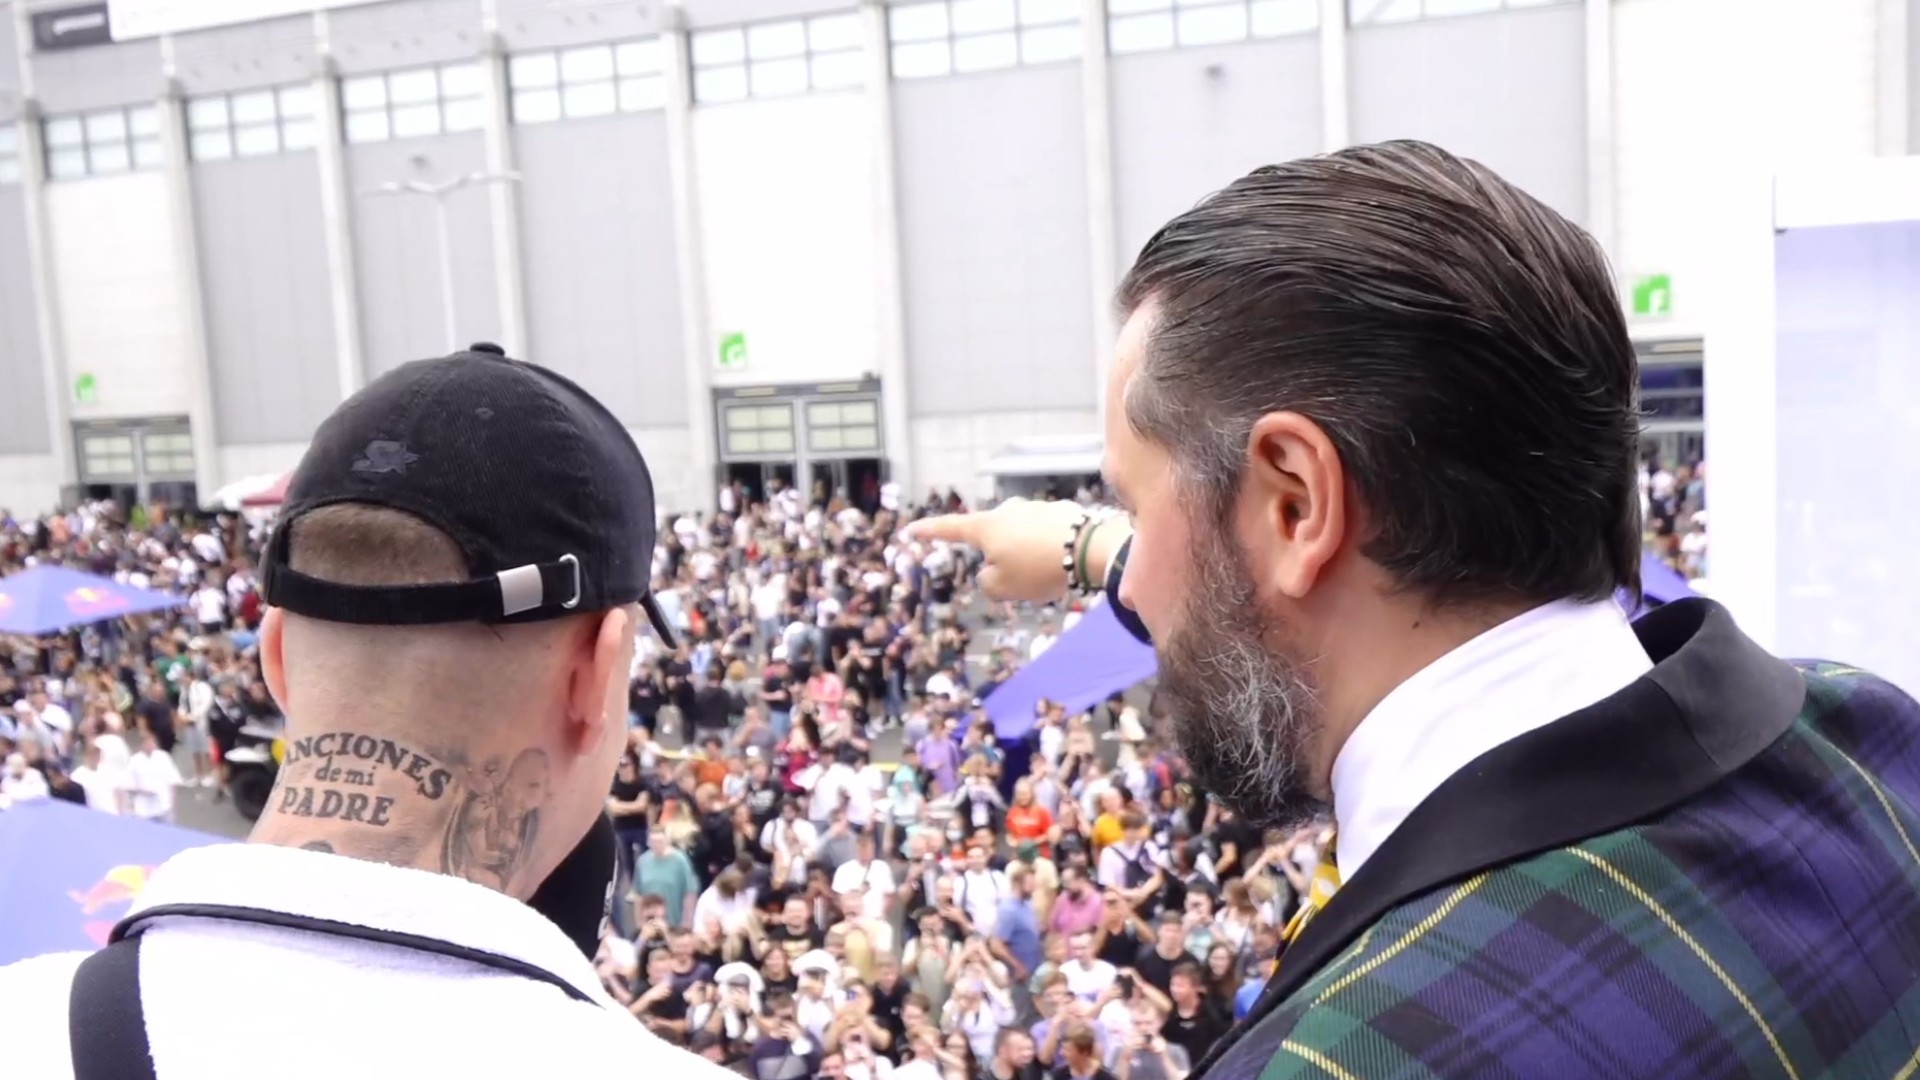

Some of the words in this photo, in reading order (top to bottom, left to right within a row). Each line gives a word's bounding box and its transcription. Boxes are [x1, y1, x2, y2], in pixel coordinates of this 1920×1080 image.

[314, 756, 342, 782] de
[344, 765, 375, 786] mi
[278, 787, 395, 827] PADRE
